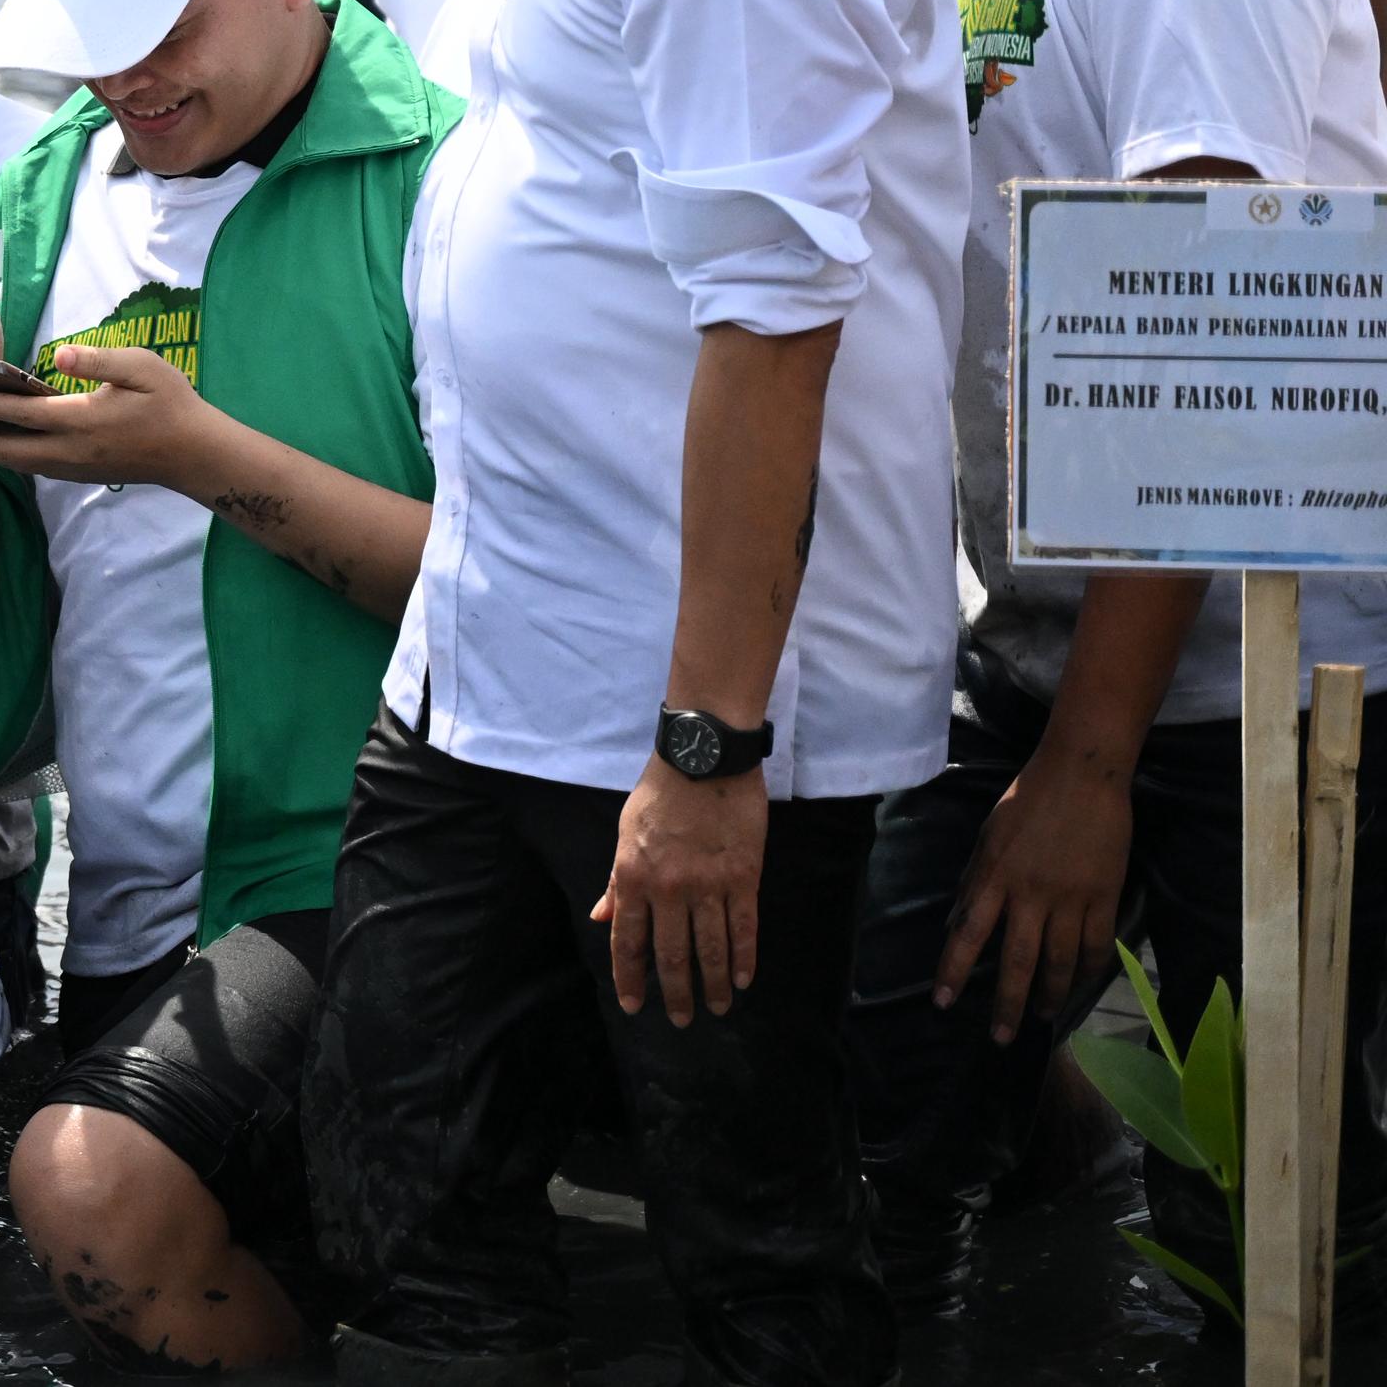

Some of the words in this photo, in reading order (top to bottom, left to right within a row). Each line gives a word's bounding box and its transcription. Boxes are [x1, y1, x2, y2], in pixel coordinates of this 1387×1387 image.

[1108, 270, 1215, 297] MENTERI
[1228, 271, 1384, 298] LINGKUNGAN
[1056, 315, 1126, 335] KEPALA
[1136, 317, 1199, 336] BADAN
[1208, 318, 1348, 338] PENGENDALIAN
[1045, 383, 1080, 408] Dr.
[1088, 384, 1161, 409] HANIF
[1175, 386, 1257, 410] FAISOL
[1137, 486, 1183, 506] JENIS
[1187, 487, 1283, 507] MANGROVE
